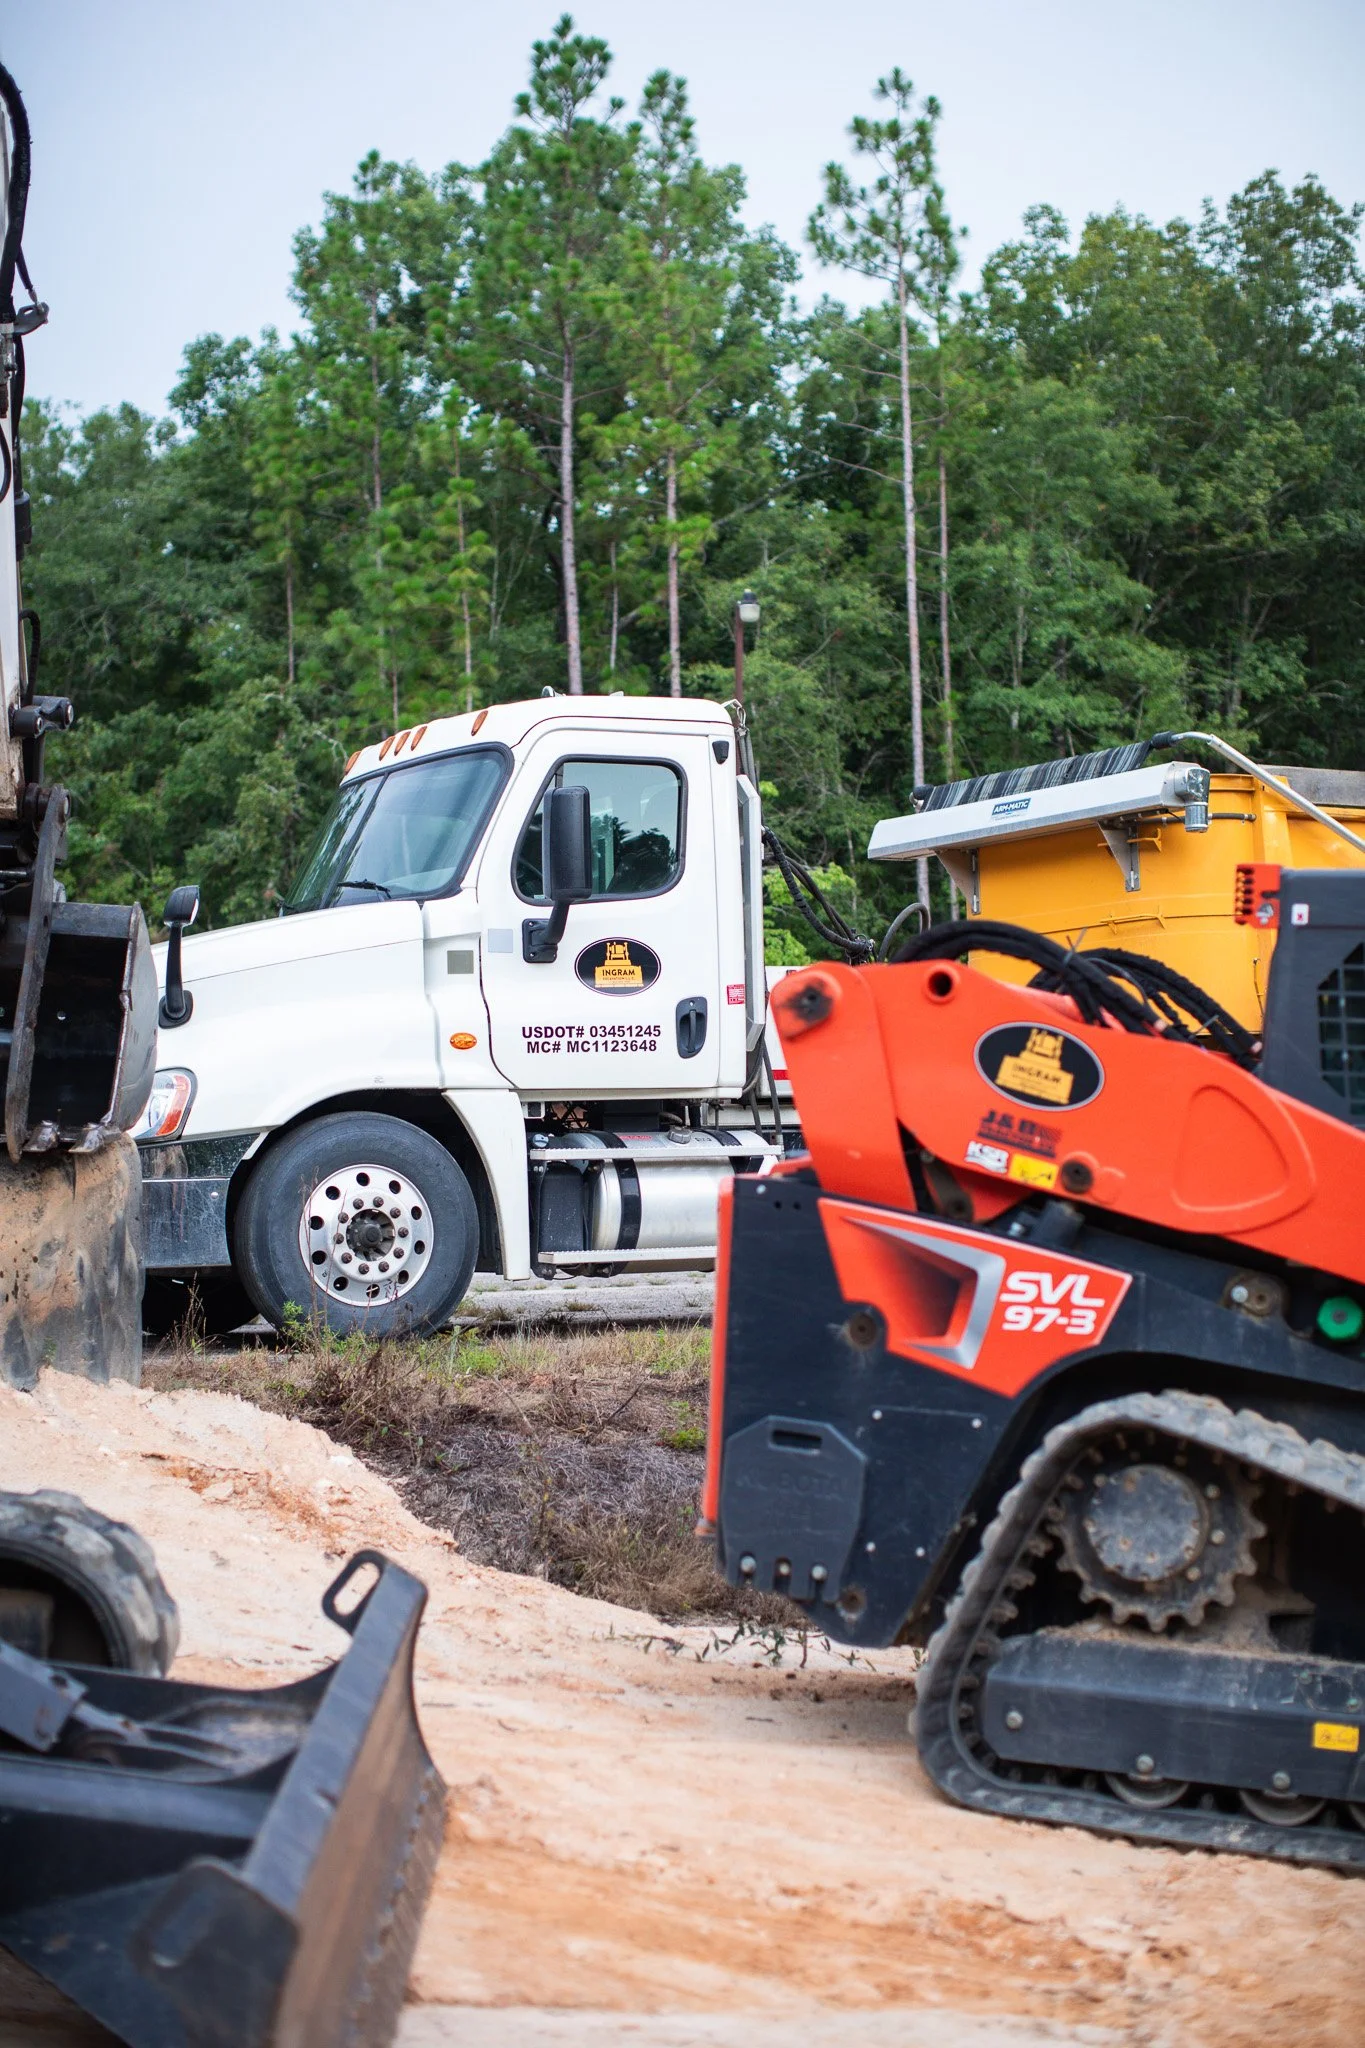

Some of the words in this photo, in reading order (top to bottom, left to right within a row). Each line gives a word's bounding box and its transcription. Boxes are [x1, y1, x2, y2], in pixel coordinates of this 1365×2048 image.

[522, 1026, 585, 1038] USDOT#
[589, 1025, 661, 1037] 03451245
[527, 1041, 561, 1053] MC#
[567, 1040, 657, 1052] MC1123648
[999, 1271, 1105, 1307] SVL
[1002, 1305, 1097, 1335] 97-3
